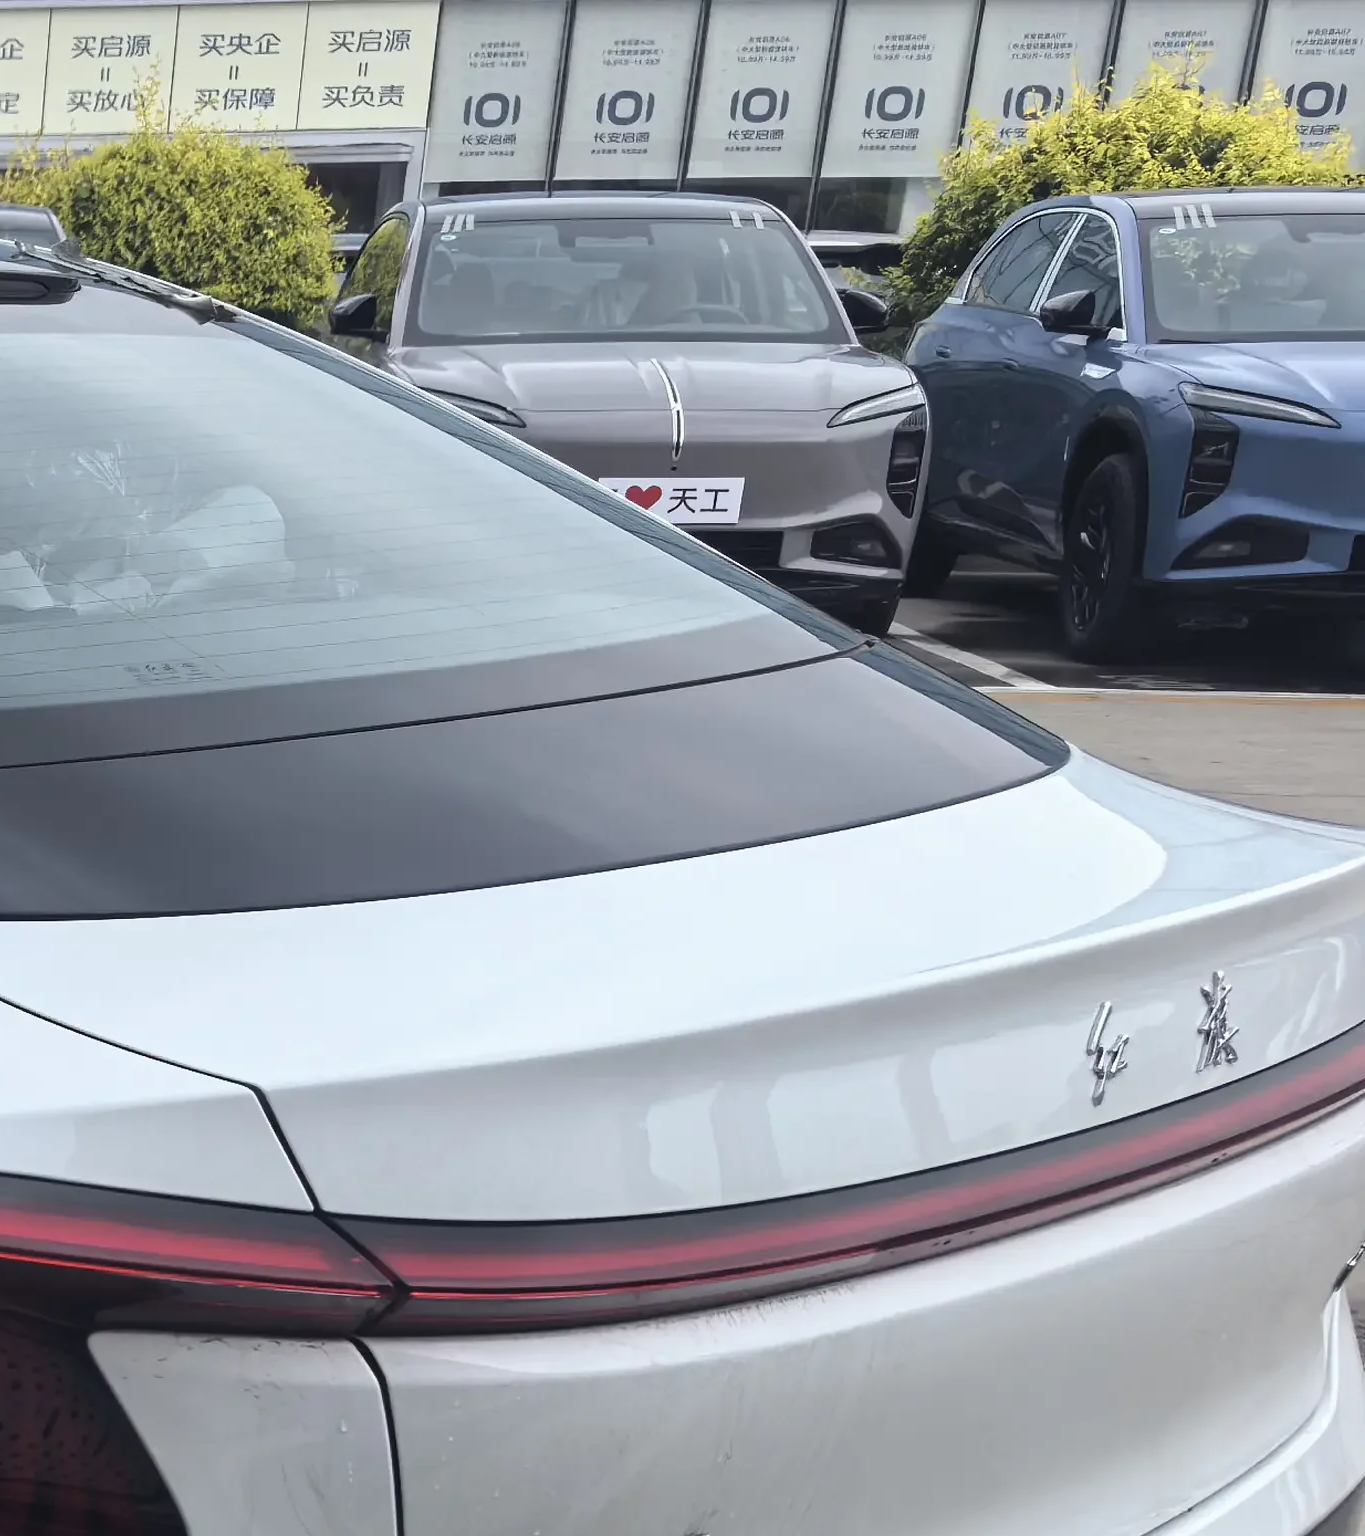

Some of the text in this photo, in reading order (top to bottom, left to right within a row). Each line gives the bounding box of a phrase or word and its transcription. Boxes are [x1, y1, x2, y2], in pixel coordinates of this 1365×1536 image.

[71, 33, 152, 59] 买启源
[199, 32, 282, 57] 买央企
[327, 28, 412, 53] 买启源
[66, 88, 151, 113] 买放心
[194, 86, 277, 111] 买保障
[321, 84, 406, 108] 买负责
[667, 488, 730, 513] 天工
